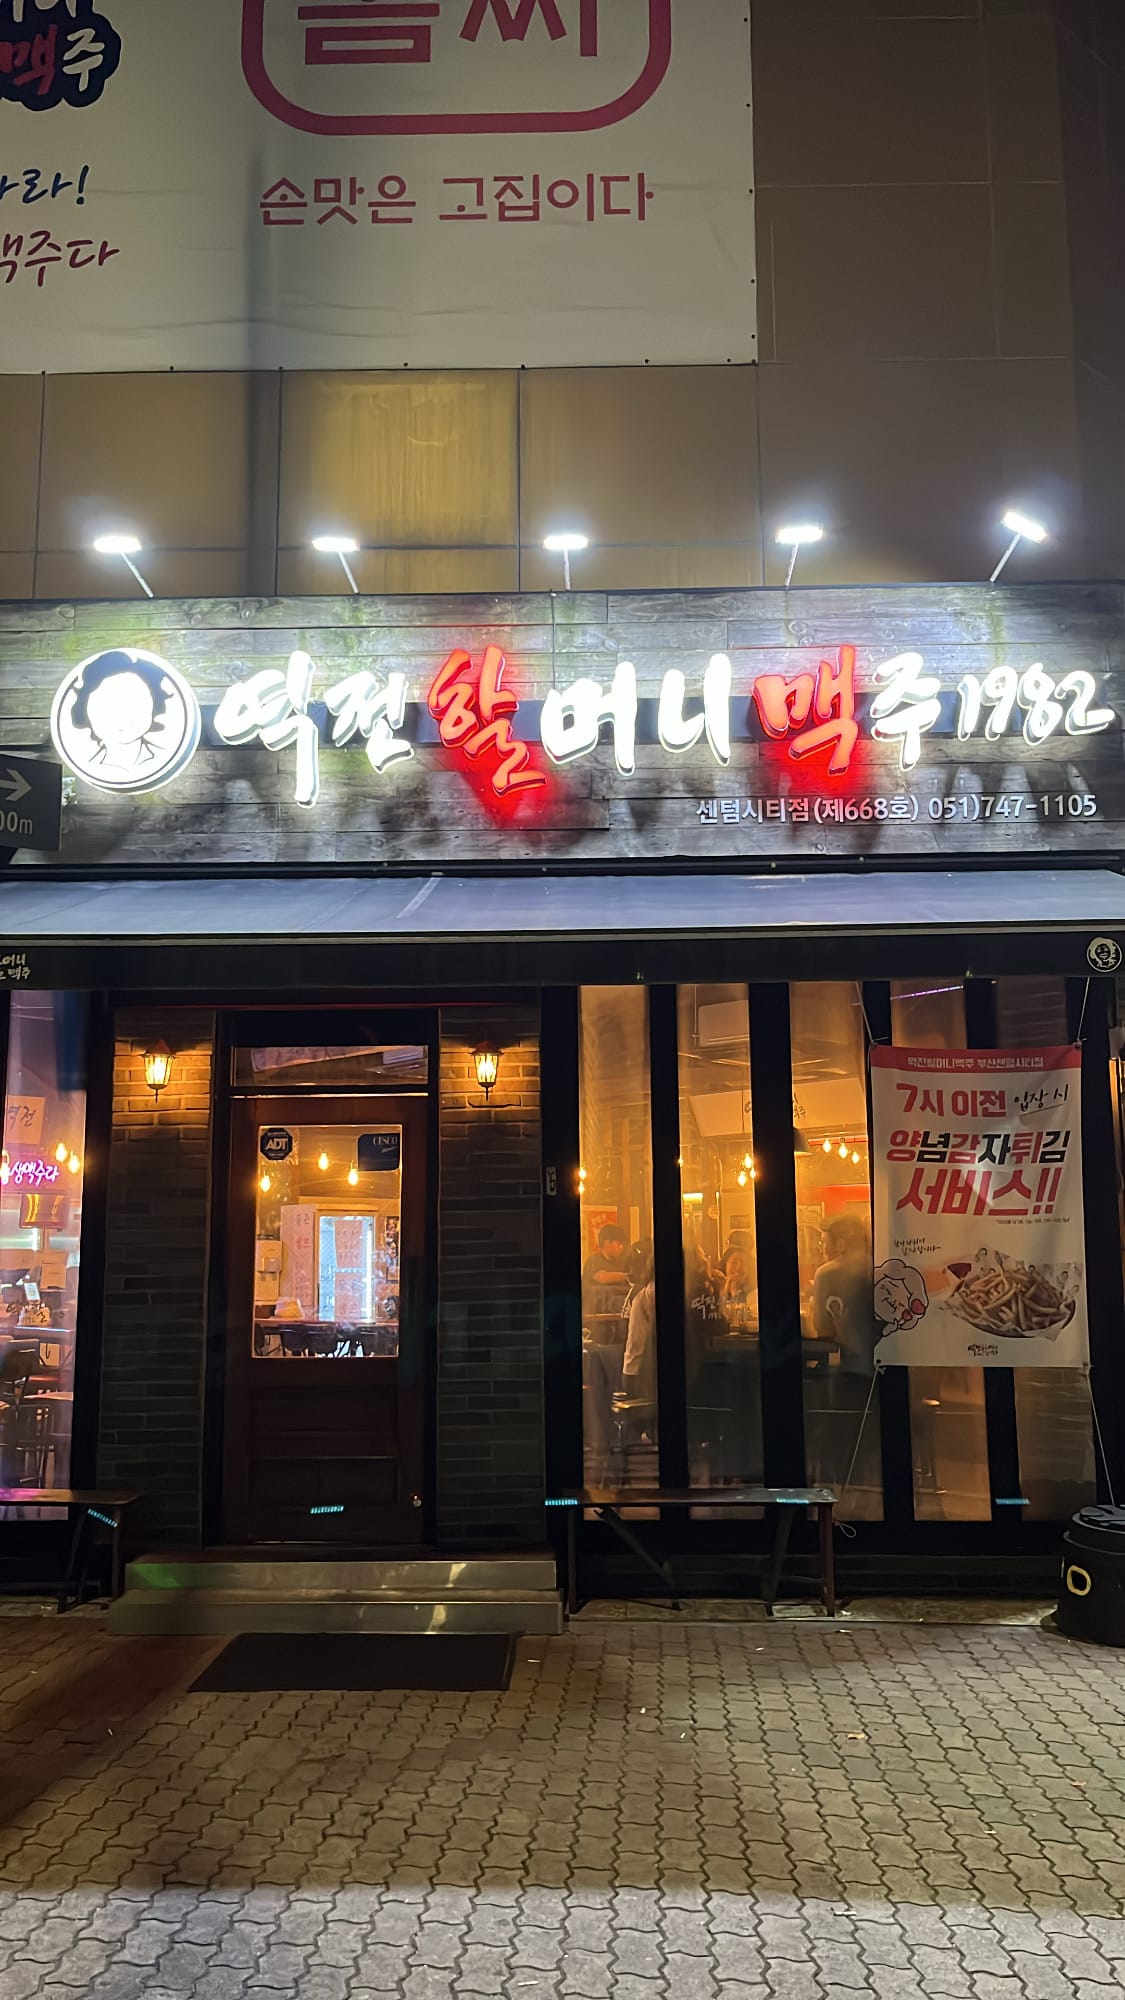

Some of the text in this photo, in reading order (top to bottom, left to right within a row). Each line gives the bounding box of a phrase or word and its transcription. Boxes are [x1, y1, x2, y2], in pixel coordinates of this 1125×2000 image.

[259, 172, 655, 226] 손맛은 고집이다
[928, 794, 1098, 822] 051)747-1105
[896, 1083, 944, 1117] 7시
[951, 1089, 1007, 1118] 이전
[265, 1138, 289, 1150] ADT
[886, 1129, 1070, 1165] 양념감자튀김
[896, 1166, 1063, 1217] 서비스!!
